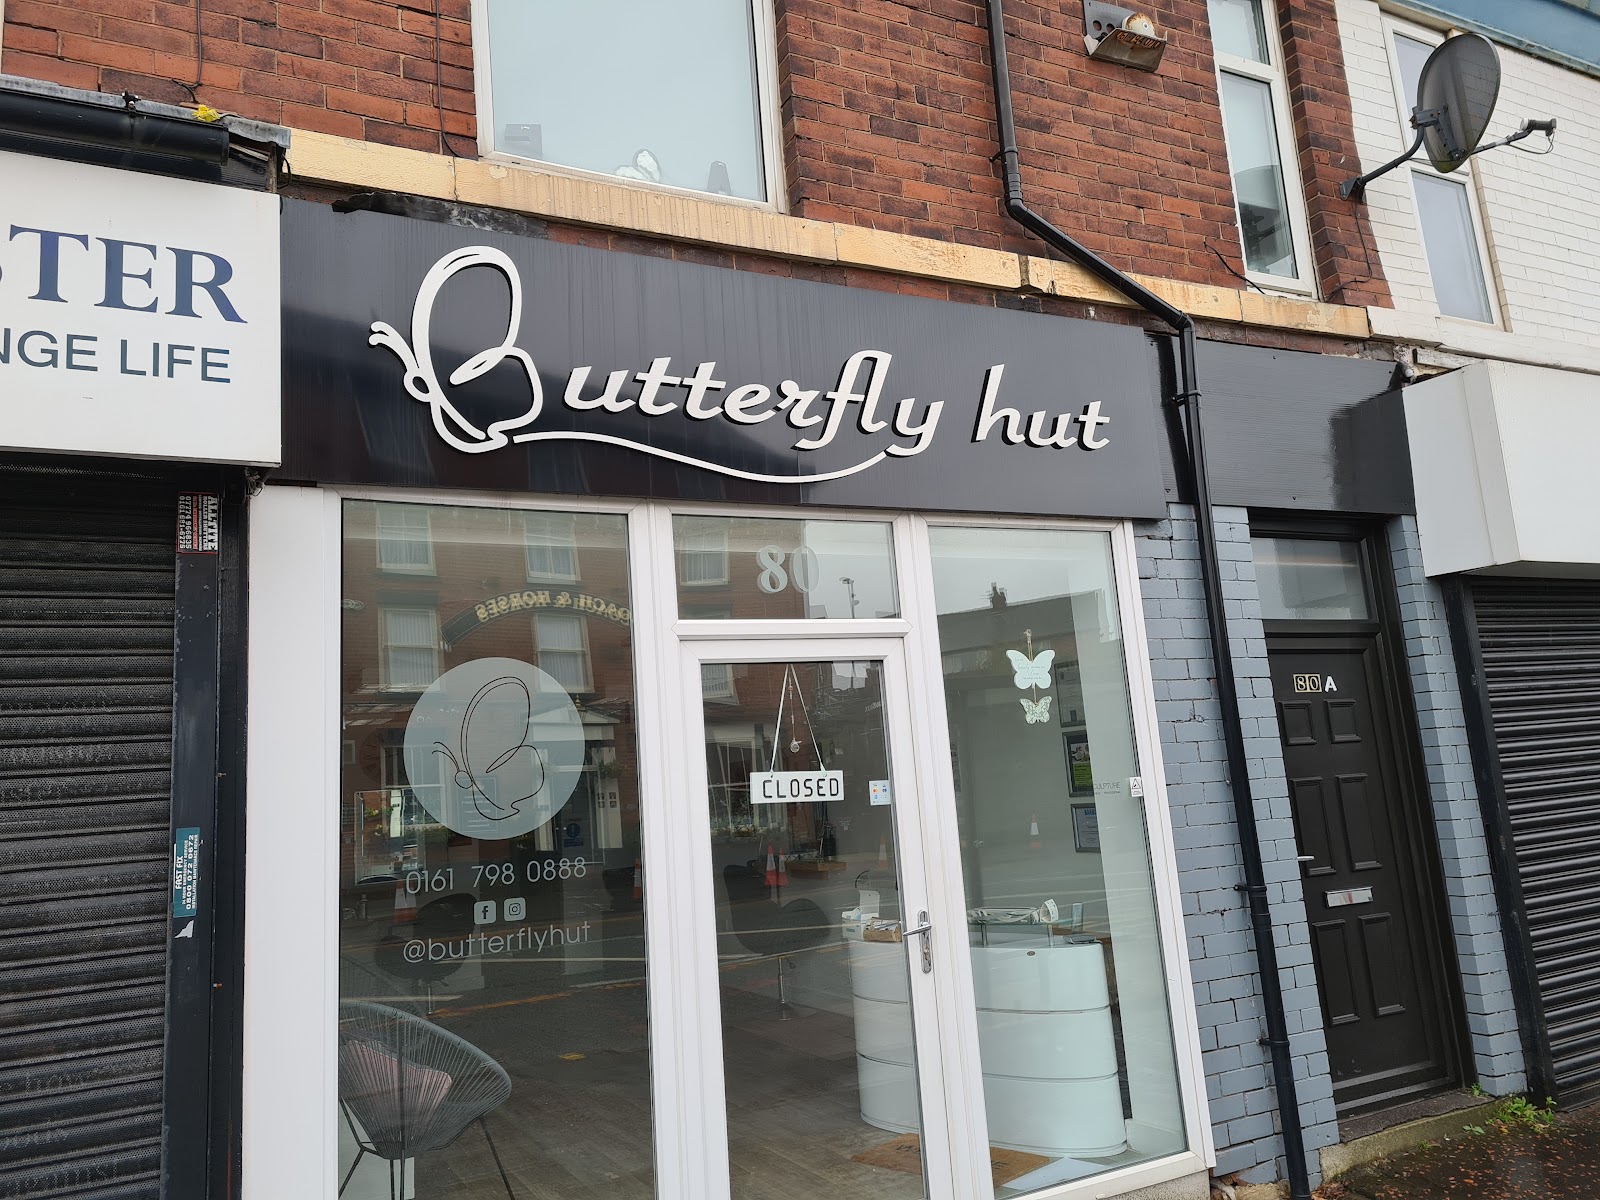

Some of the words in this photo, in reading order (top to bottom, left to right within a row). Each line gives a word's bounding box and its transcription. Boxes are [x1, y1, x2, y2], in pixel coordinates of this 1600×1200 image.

[0, 225, 248, 323] TER
[120, 338, 231, 384] LIFE
[369, 246, 944, 456] Butterfly
[975, 363, 1111, 450] hut
[756, 544, 820, 593] 80
[762, 777, 840, 799] CLOSED
[175, 870, 183, 890] FAST
[405, 868, 455, 895] 0161
[471, 862, 515, 888] 798
[526, 856, 587, 883] 0888
[403, 920, 591, 963] @butterflyhut
